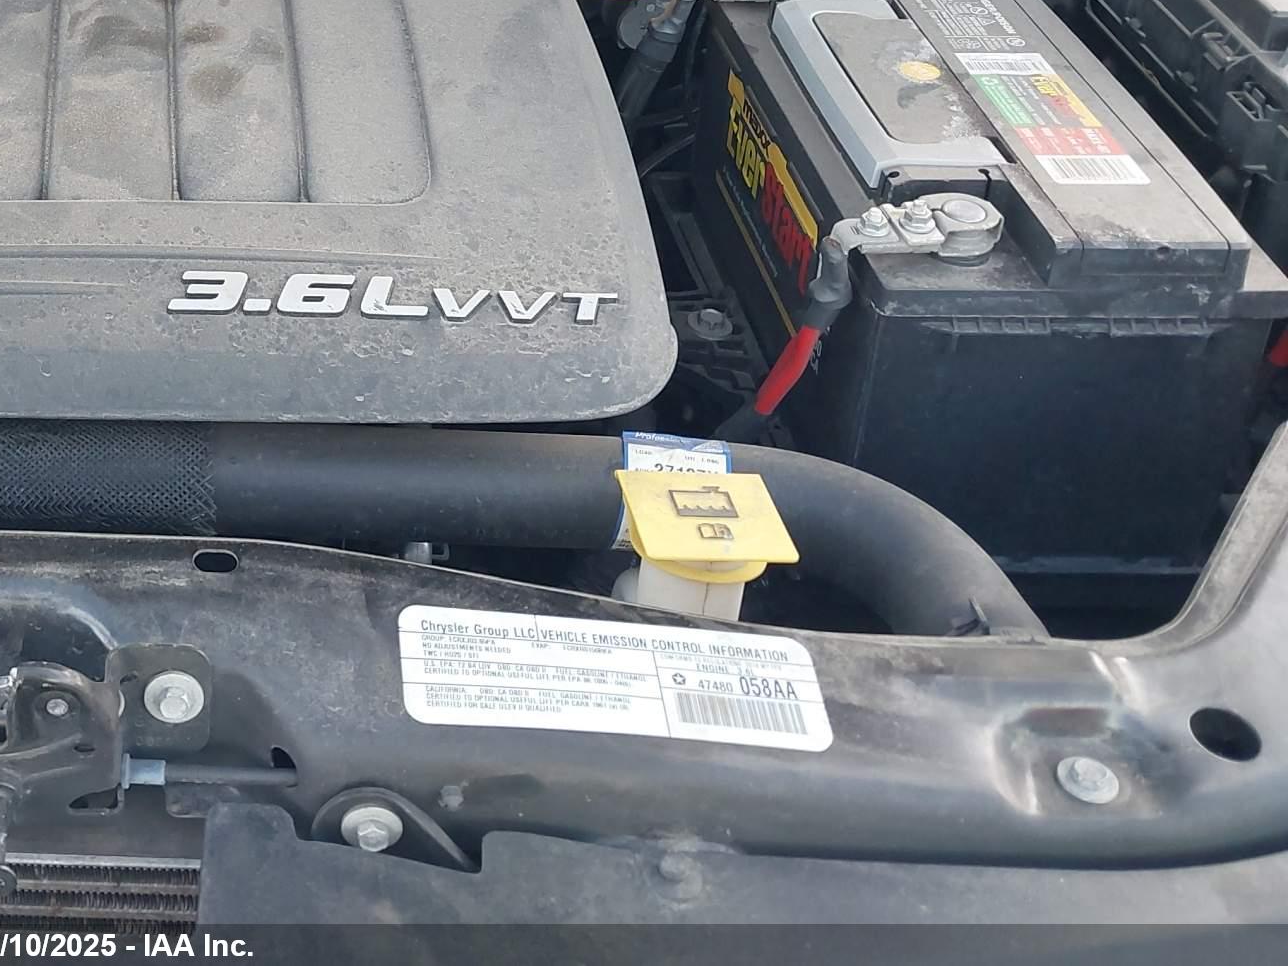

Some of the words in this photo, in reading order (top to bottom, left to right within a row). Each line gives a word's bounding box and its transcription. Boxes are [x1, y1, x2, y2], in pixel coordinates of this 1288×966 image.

[420, 619, 469, 636] Chrysler
[473, 623, 509, 639] Group
[513, 627, 535, 638] LLC
[540, 629, 587, 643] VEHICLE
[592, 633, 647, 648] EMISSION
[651, 638, 705, 653] CONTROL
[707, 644, 788, 661] INFORMATION
[697, 678, 733, 692] 47480
[738, 676, 798, 699] 058AA
